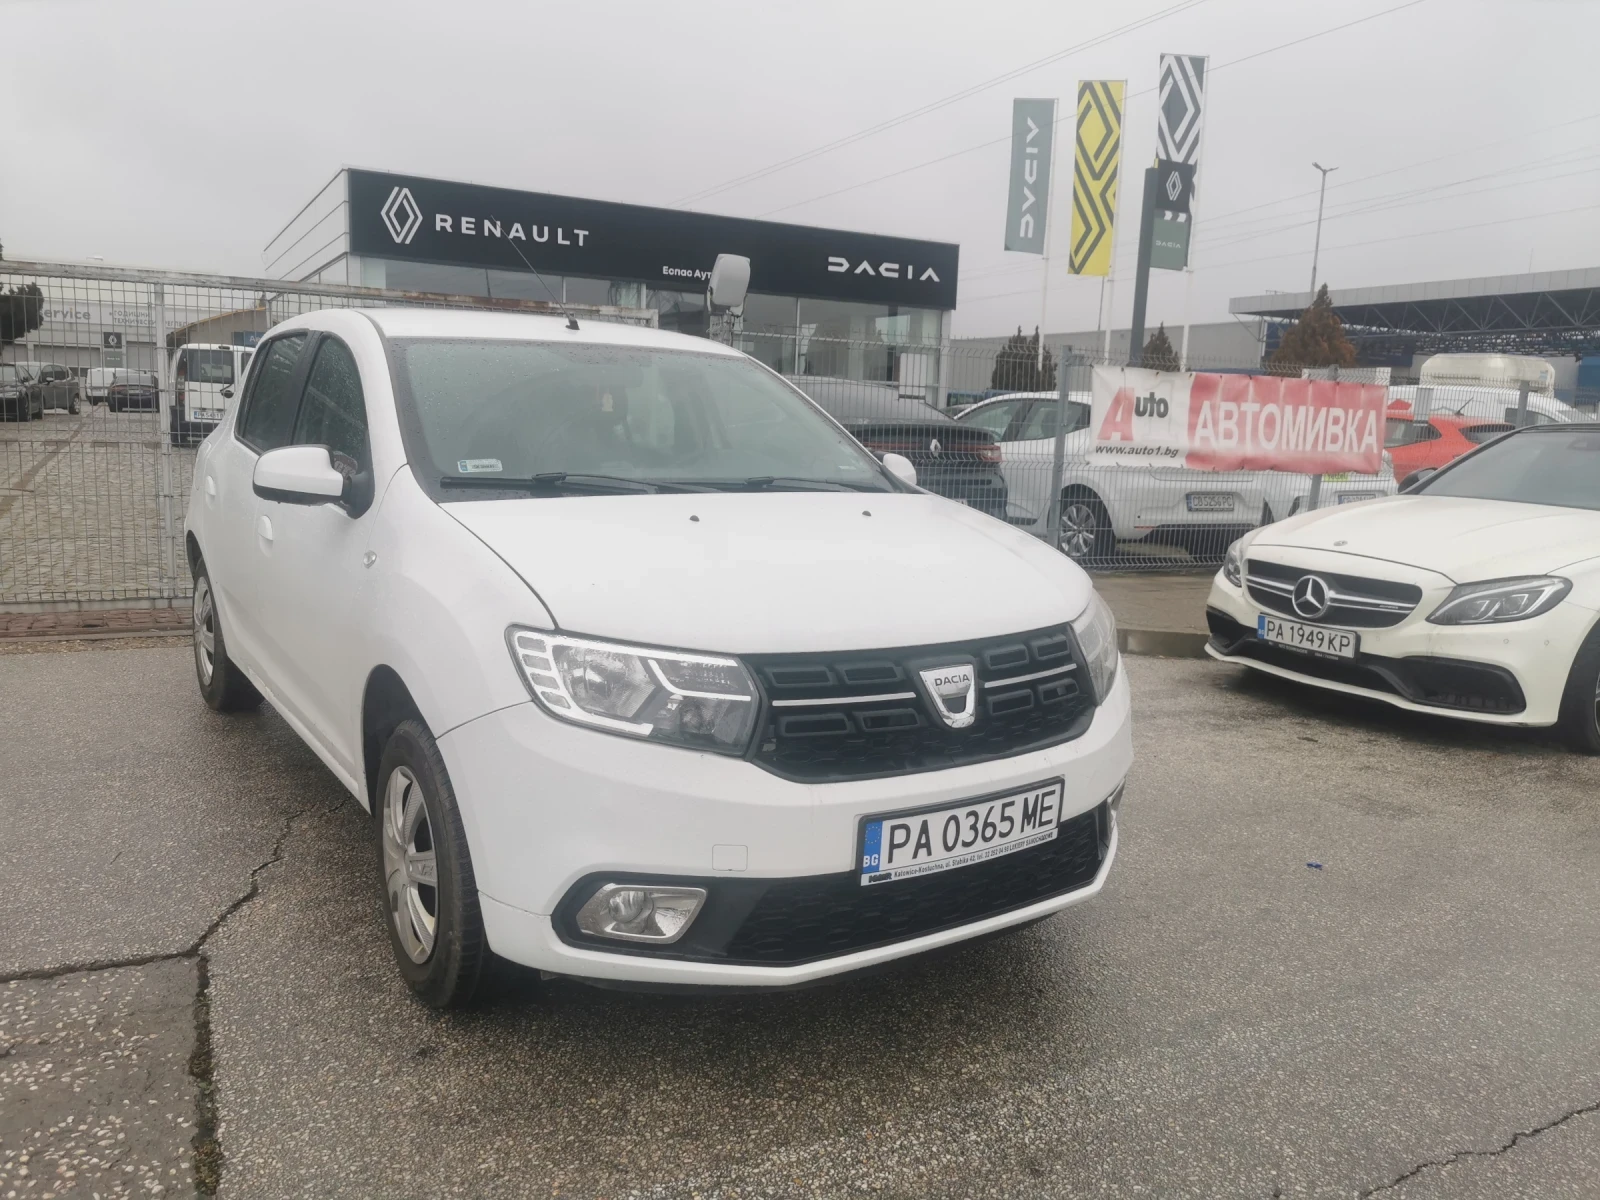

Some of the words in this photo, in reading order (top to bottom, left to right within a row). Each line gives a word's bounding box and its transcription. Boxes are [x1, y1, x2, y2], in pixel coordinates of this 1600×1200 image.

[1019, 116, 1039, 238] DACIA
[435, 213, 589, 247] RENAULT
[1155, 240, 1182, 249] DACIA
[662, 265, 693, 277] Еспас
[693, 269, 712, 281] Аут
[828, 256, 940, 282] DACIA
[43, 307, 91, 320] ervice
[1194, 400, 1378, 454] АВТОМИВКА
[1095, 444, 1179, 459] www.auto1.bg
[1266, 620, 1284, 640] PA
[1289, 625, 1325, 648] 1949
[1327, 632, 1351, 653] KP
[934, 673, 970, 687] DACIA
[863, 853, 879, 868] BG
[887, 819, 932, 864] PA
[942, 800, 1015, 853] 0365
[1020, 789, 1056, 834] ME
